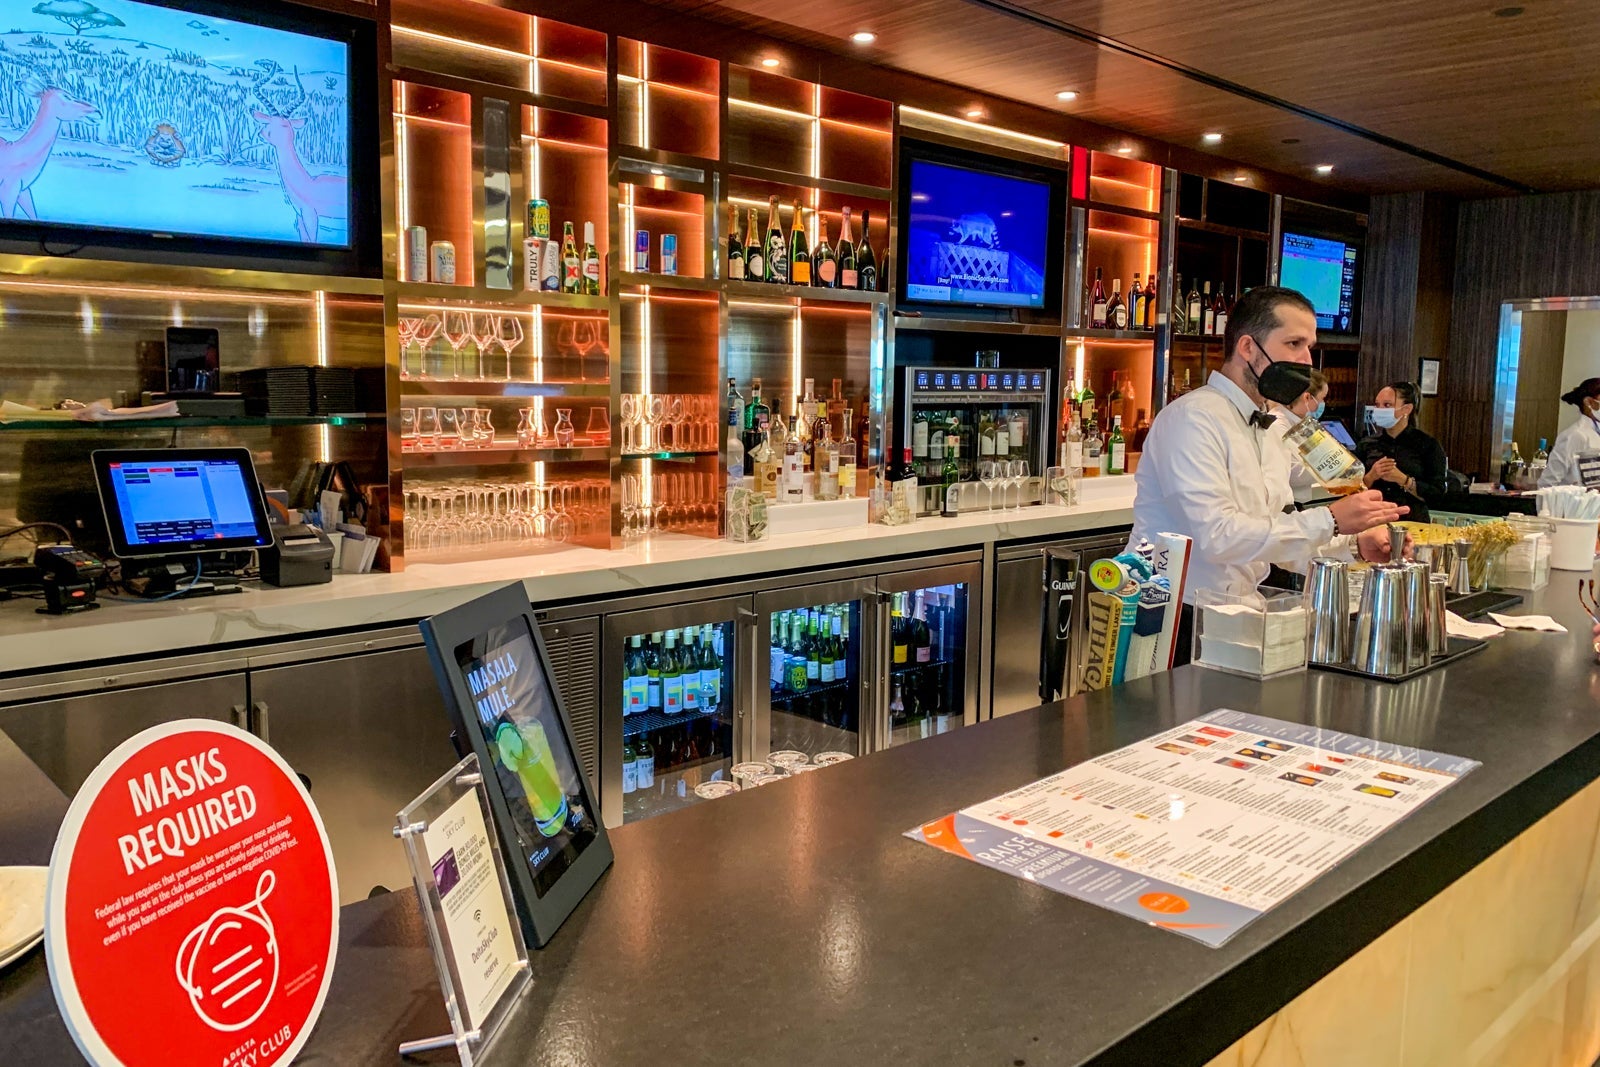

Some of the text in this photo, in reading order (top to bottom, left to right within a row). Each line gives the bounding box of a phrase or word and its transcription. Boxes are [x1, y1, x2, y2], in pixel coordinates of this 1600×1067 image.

[530, 250, 538, 283] TRULY
[1316, 449, 1343, 471] FORESTER
[1113, 608, 1121, 627] LAKES
[1109, 628, 1119, 652] FINGER
[467, 652, 518, 696] MASALA
[127, 747, 228, 817] MASKS
[118, 784, 257, 875] REQUIRED
[975, 836, 1035, 862] RAISE
[998, 844, 1052, 868] THE BAR
[95, 896, 122, 919] Federal
[135, 878, 162, 901] requires
[162, 872, 176, 887] that
[175, 866, 190, 883] your
[190, 857, 206, 873] mask
[214, 847, 229, 860] worn
[229, 841, 241, 853] over
[241, 835, 254, 849] your
[106, 913, 126, 929] while
[170, 883, 185, 897] club
[184, 872, 204, 889] unless
[225, 852, 247, 869] actively
[246, 843, 263, 860] eating
[103, 930, 121, 946] even
[141, 911, 157, 926] have
[157, 898, 184, 917] received
[194, 880, 217, 898] vaccine
[223, 869, 237, 882] have
[241, 858, 264, 873] negative
[471, 927, 498, 964] DeltaSkyClub
[484, 958, 499, 981] reserve
[230, 1038, 256, 1061] DELTA
[260, 1024, 292, 1057] CLUB
